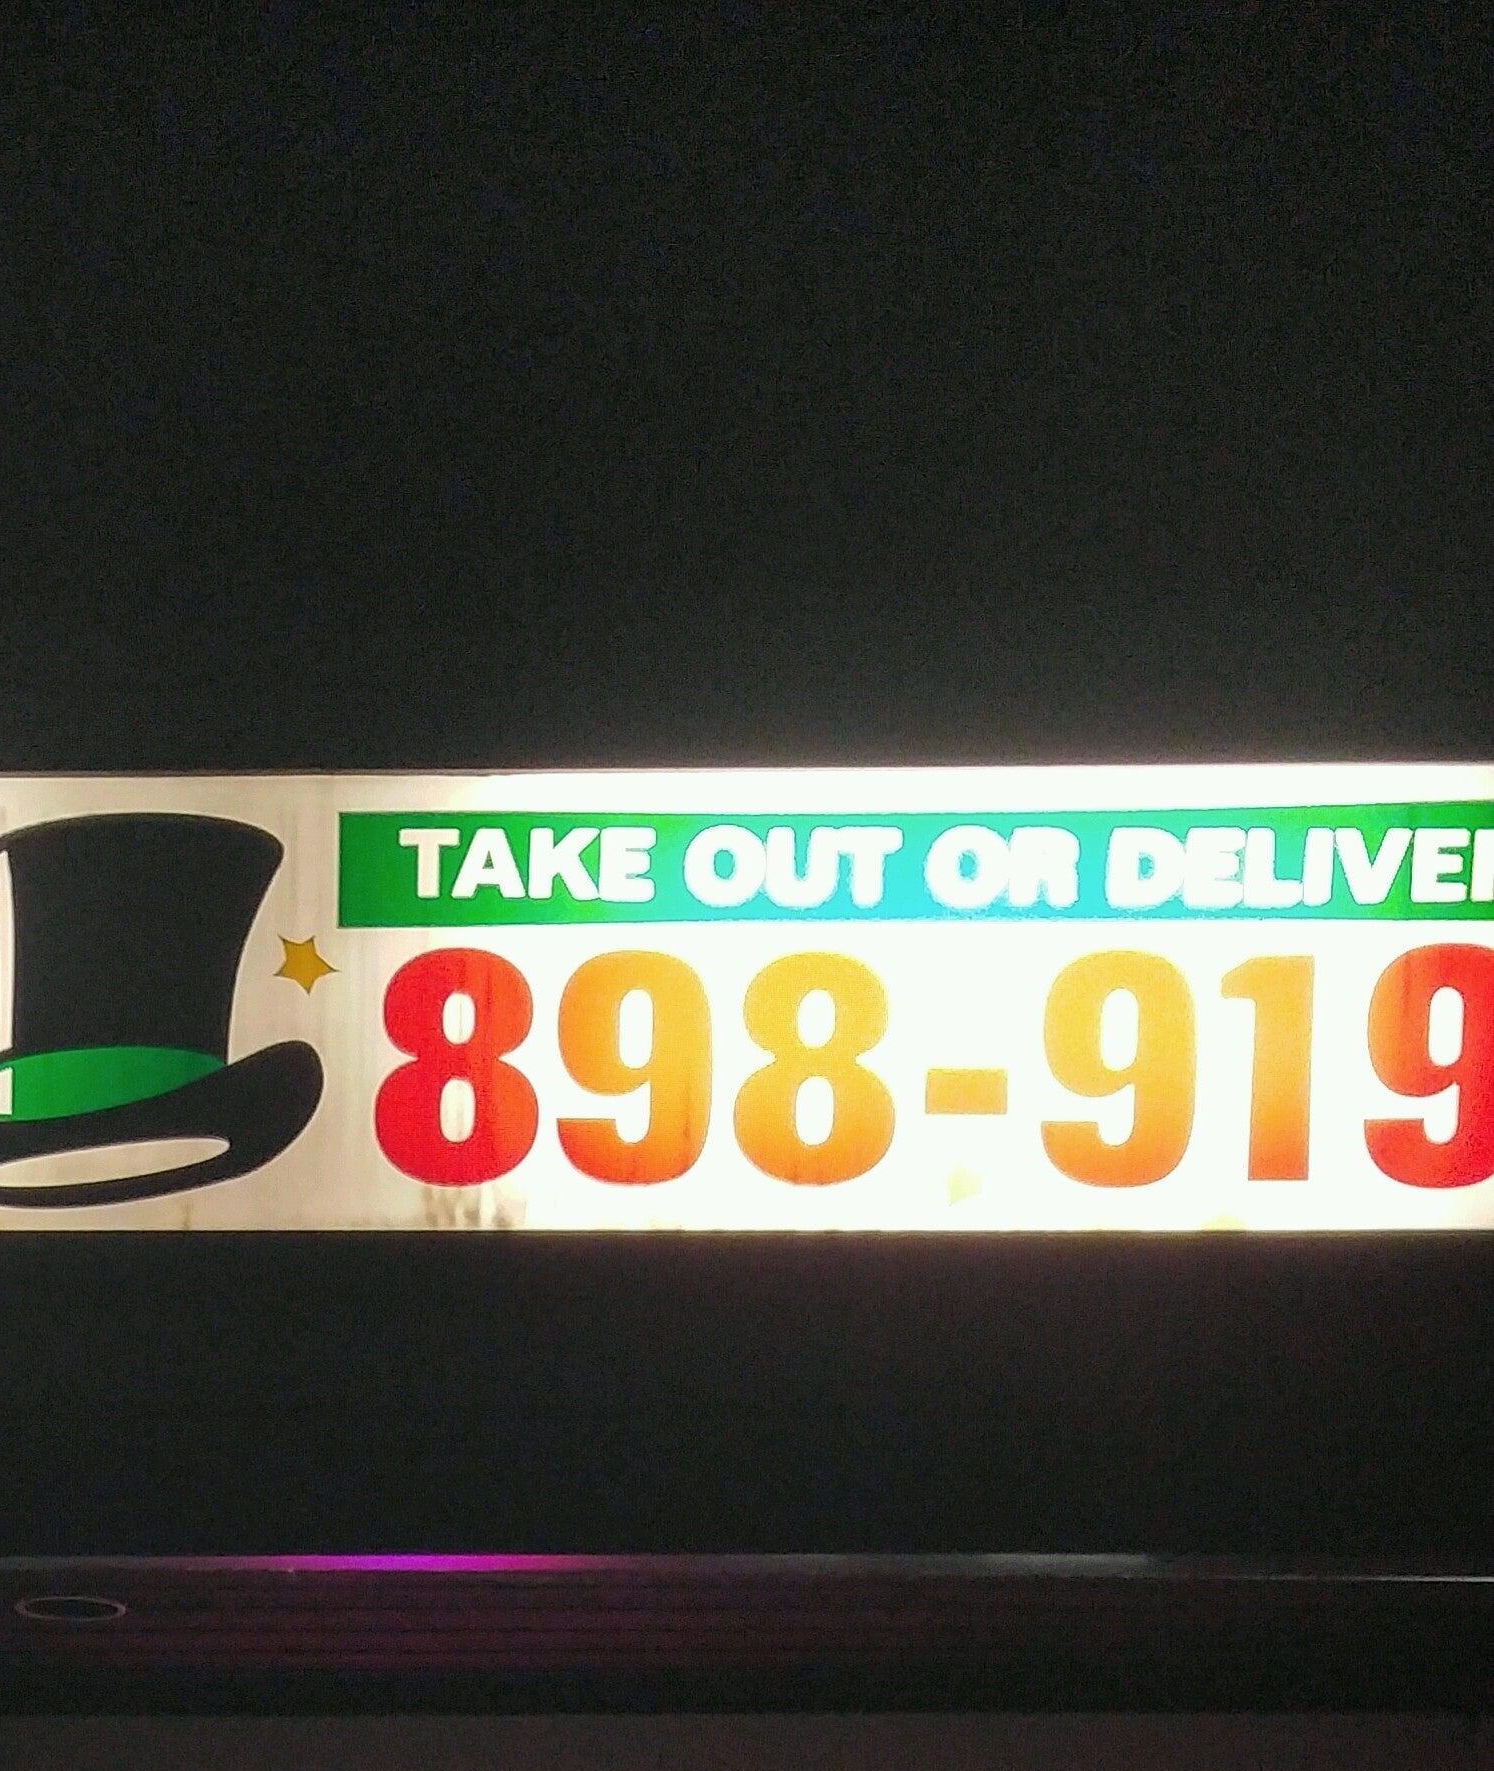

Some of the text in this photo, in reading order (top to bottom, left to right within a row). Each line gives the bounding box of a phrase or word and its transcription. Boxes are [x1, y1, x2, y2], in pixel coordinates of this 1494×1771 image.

[399, 825, 1494, 912] TAKE OUT OR DELIVE
[373, 943, 1494, 1189] 898-919
